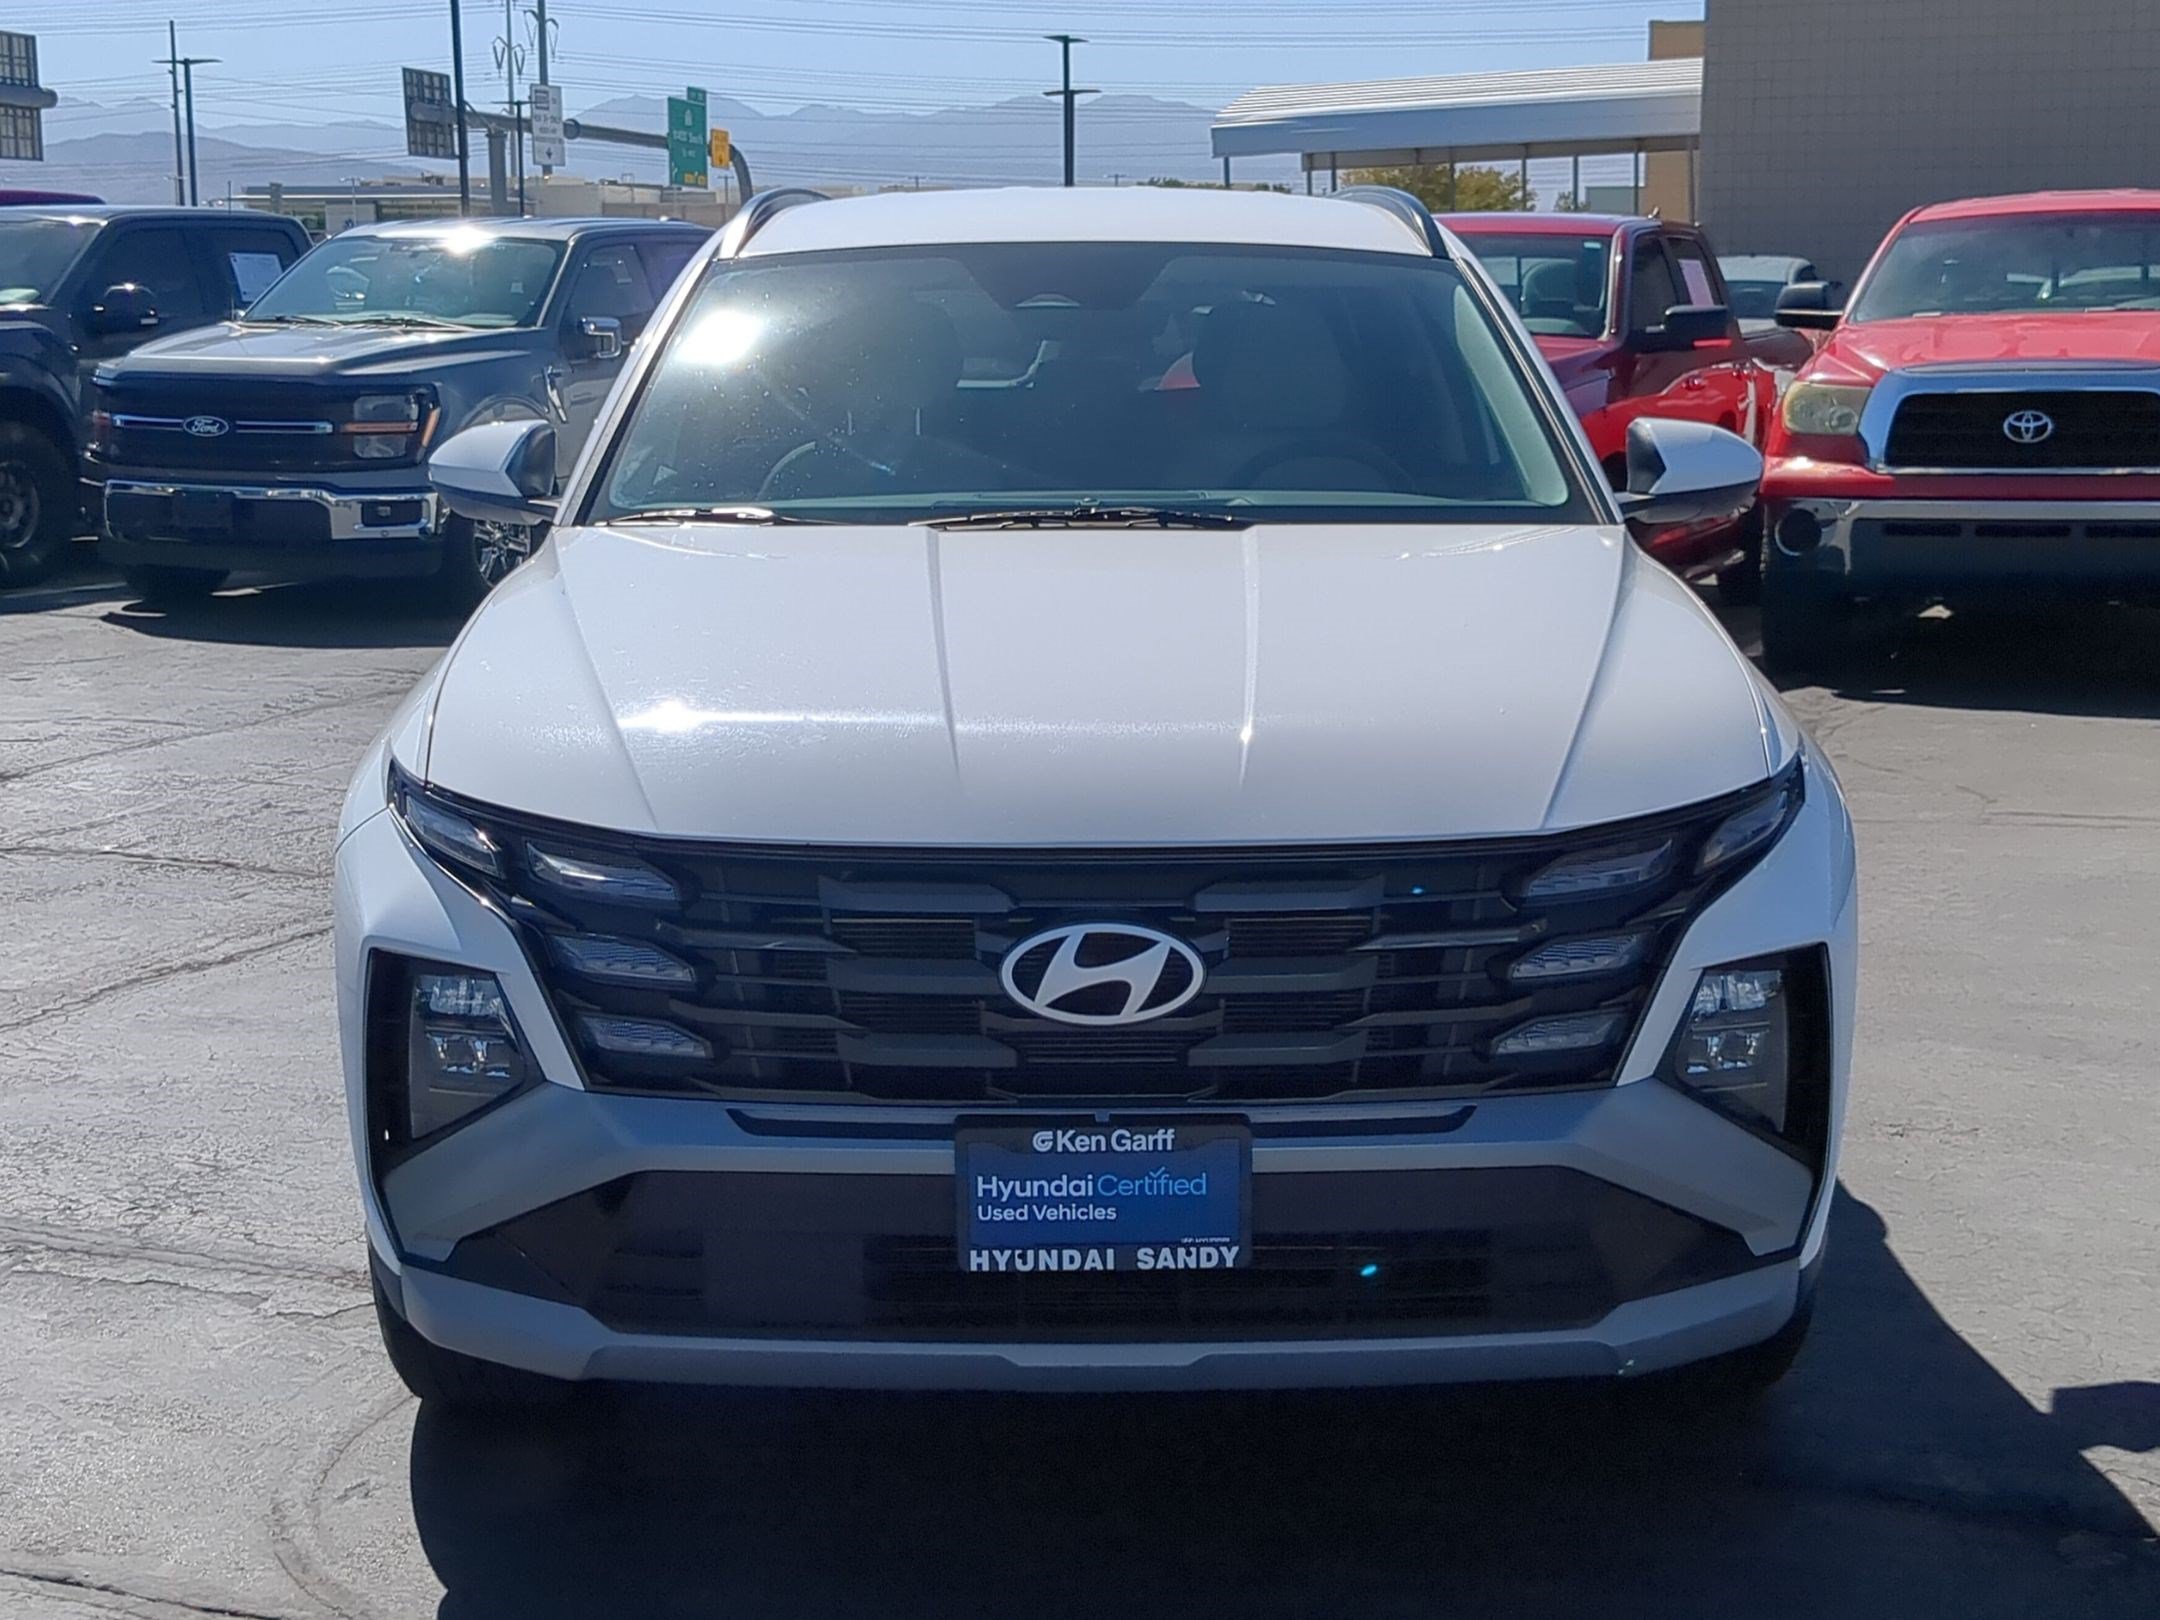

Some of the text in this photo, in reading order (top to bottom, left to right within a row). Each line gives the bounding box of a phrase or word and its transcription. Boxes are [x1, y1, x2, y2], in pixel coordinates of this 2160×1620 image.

[190, 418, 221, 434] Ford
[1057, 1128, 1175, 1153] Ken Garff
[977, 1168, 1207, 1202] Hyundai Certified
[978, 1203, 1117, 1221] Used Vehicles
[970, 1246, 1239, 1272] HYUNDAI SANDY
